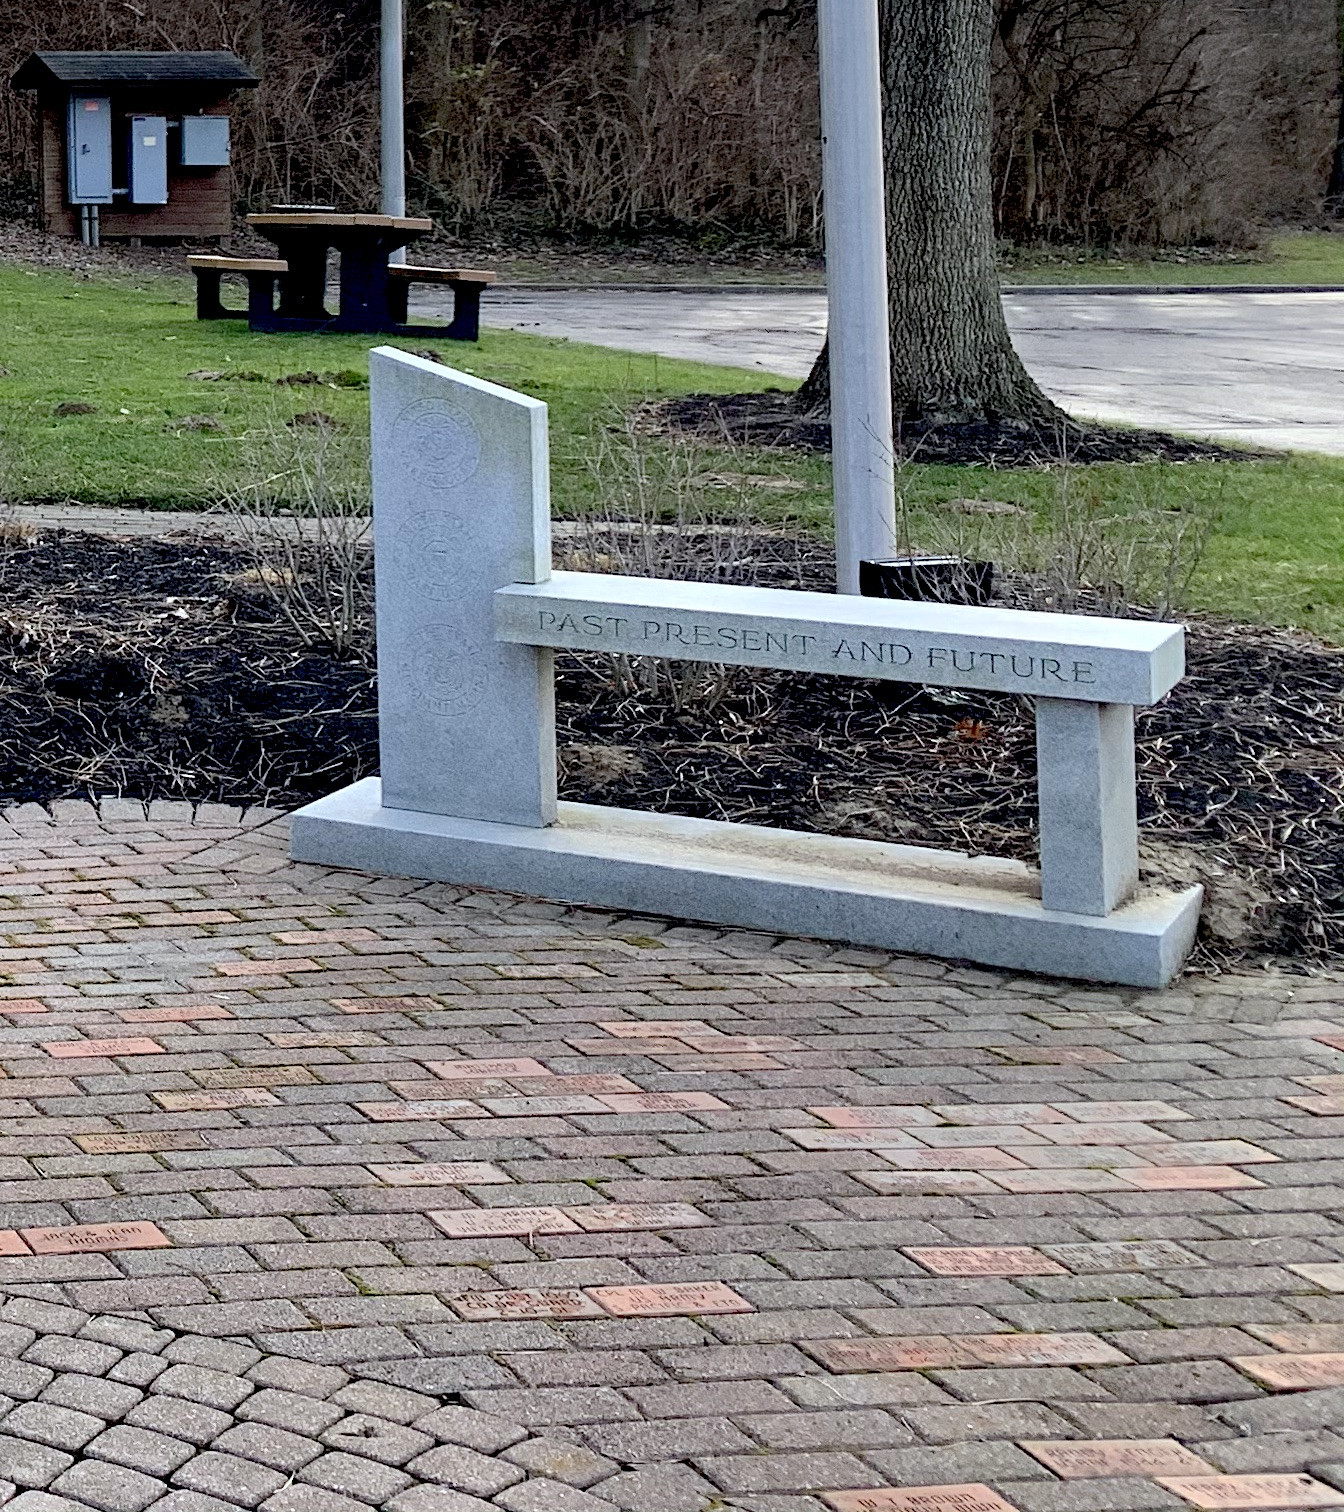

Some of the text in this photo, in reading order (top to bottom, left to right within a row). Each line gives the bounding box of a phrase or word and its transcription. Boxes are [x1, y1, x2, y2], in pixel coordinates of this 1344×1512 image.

[538, 610, 1098, 684] PAST PRESENT AND FUTURE
